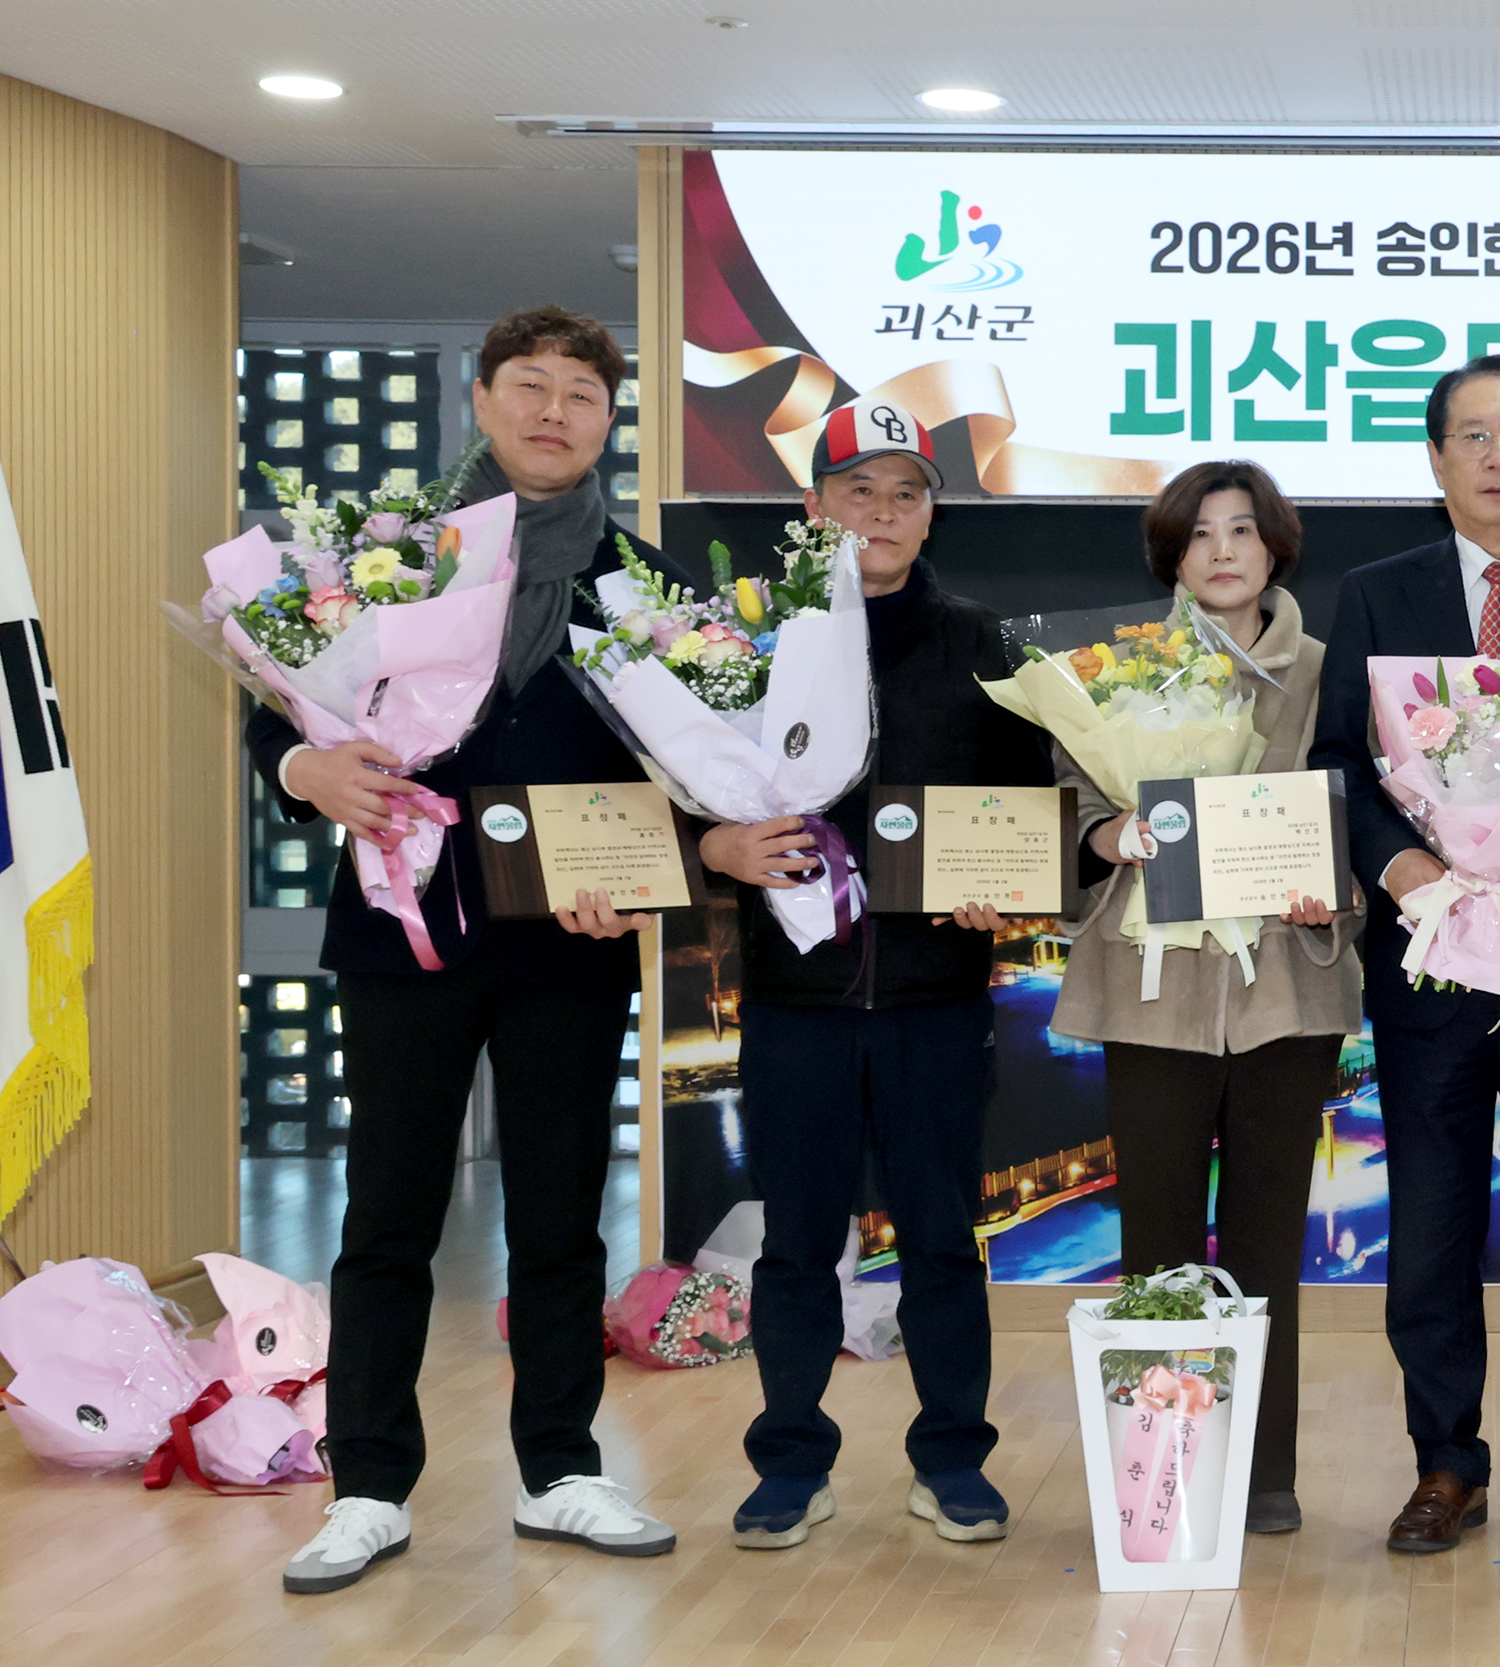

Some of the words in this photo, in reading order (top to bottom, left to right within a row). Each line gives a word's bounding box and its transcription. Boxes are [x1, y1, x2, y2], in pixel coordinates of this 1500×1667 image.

[1150, 221, 1353, 276] 2026년
[874, 302, 1035, 342] 괴산군
[871, 405, 908, 444] OB
[971, 816, 1015, 825] 표창패
[1242, 807, 1285, 818] 표창패
